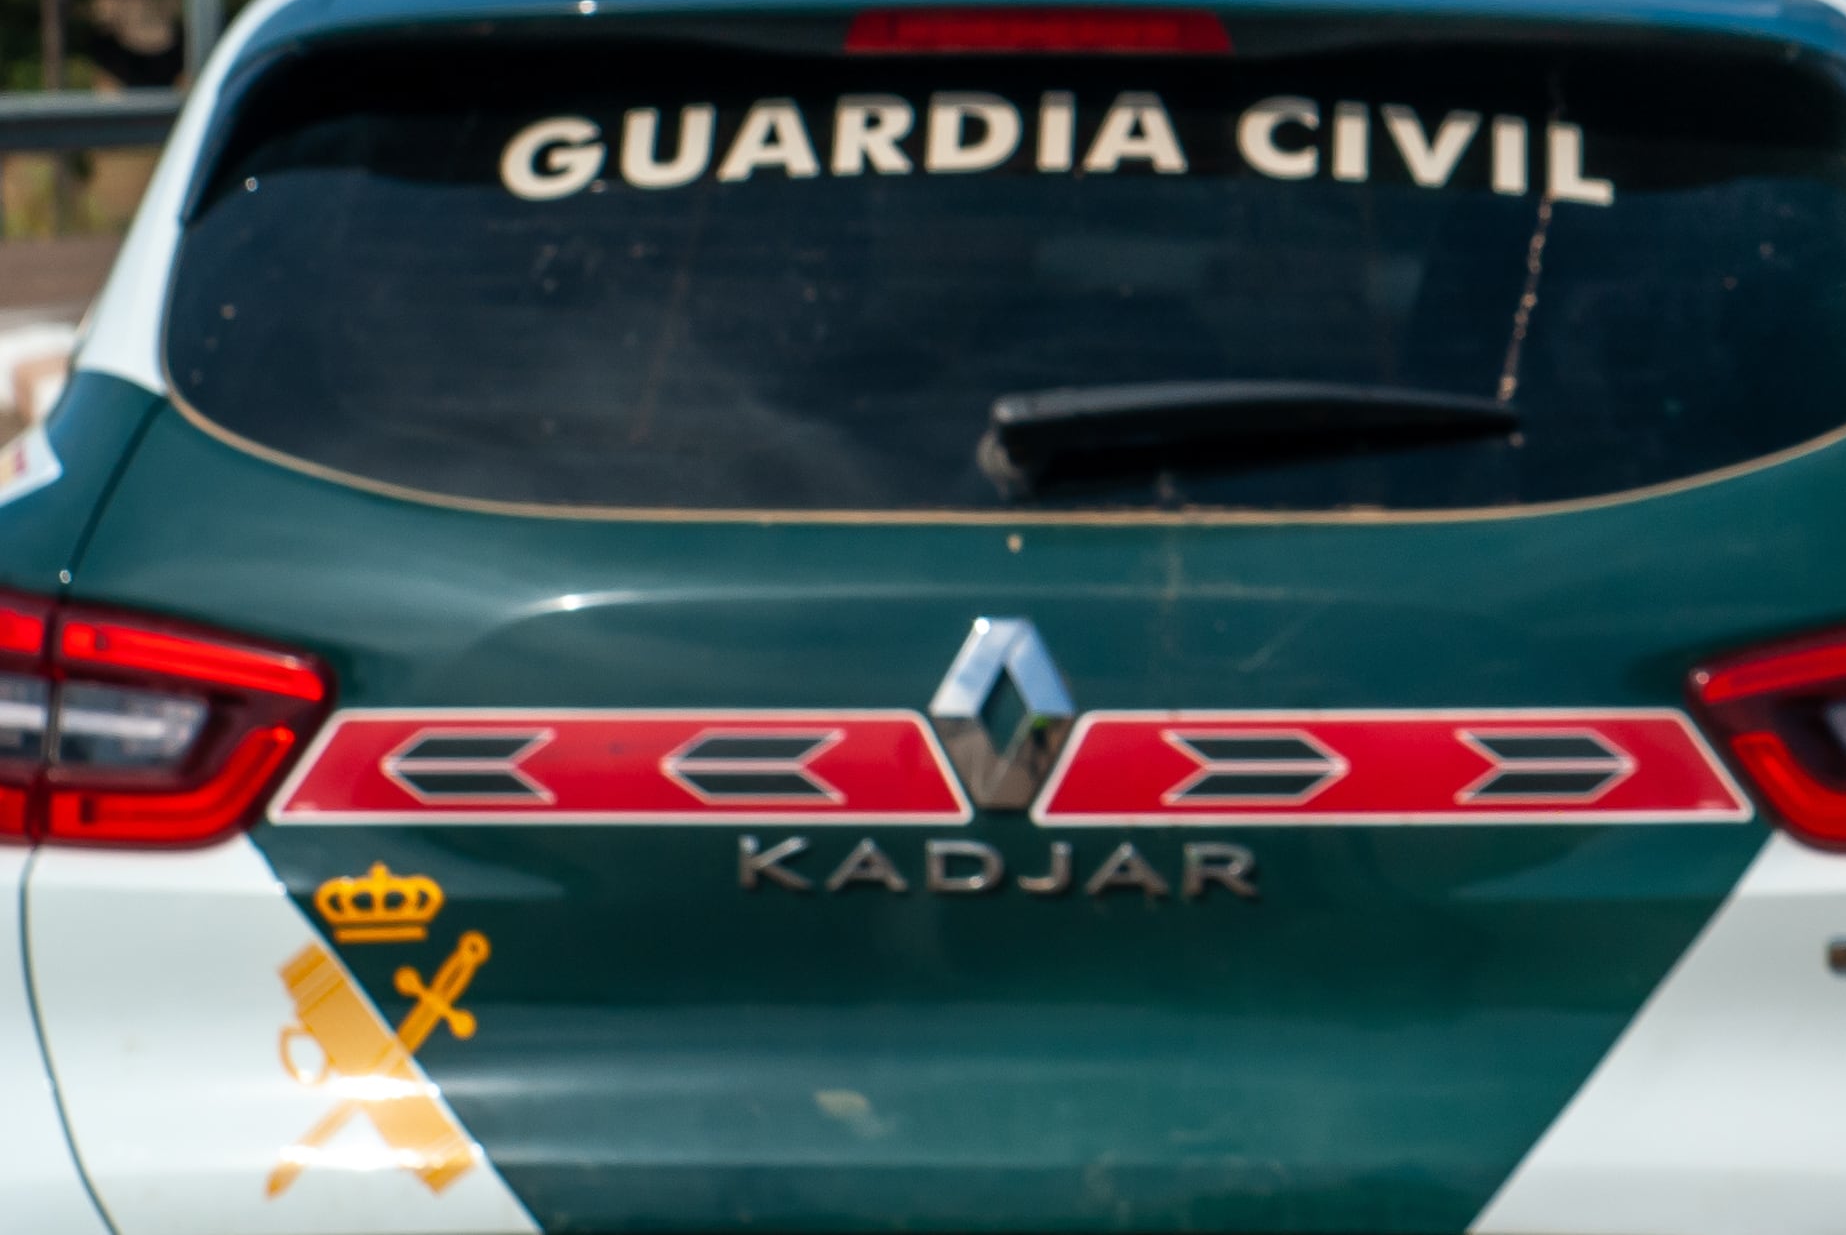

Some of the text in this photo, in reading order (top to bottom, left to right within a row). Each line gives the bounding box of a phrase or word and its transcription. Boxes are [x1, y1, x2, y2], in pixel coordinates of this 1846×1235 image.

[500, 90, 1615, 207] GUARDIA CIVIL
[736, 834, 1261, 898] KADJAR
